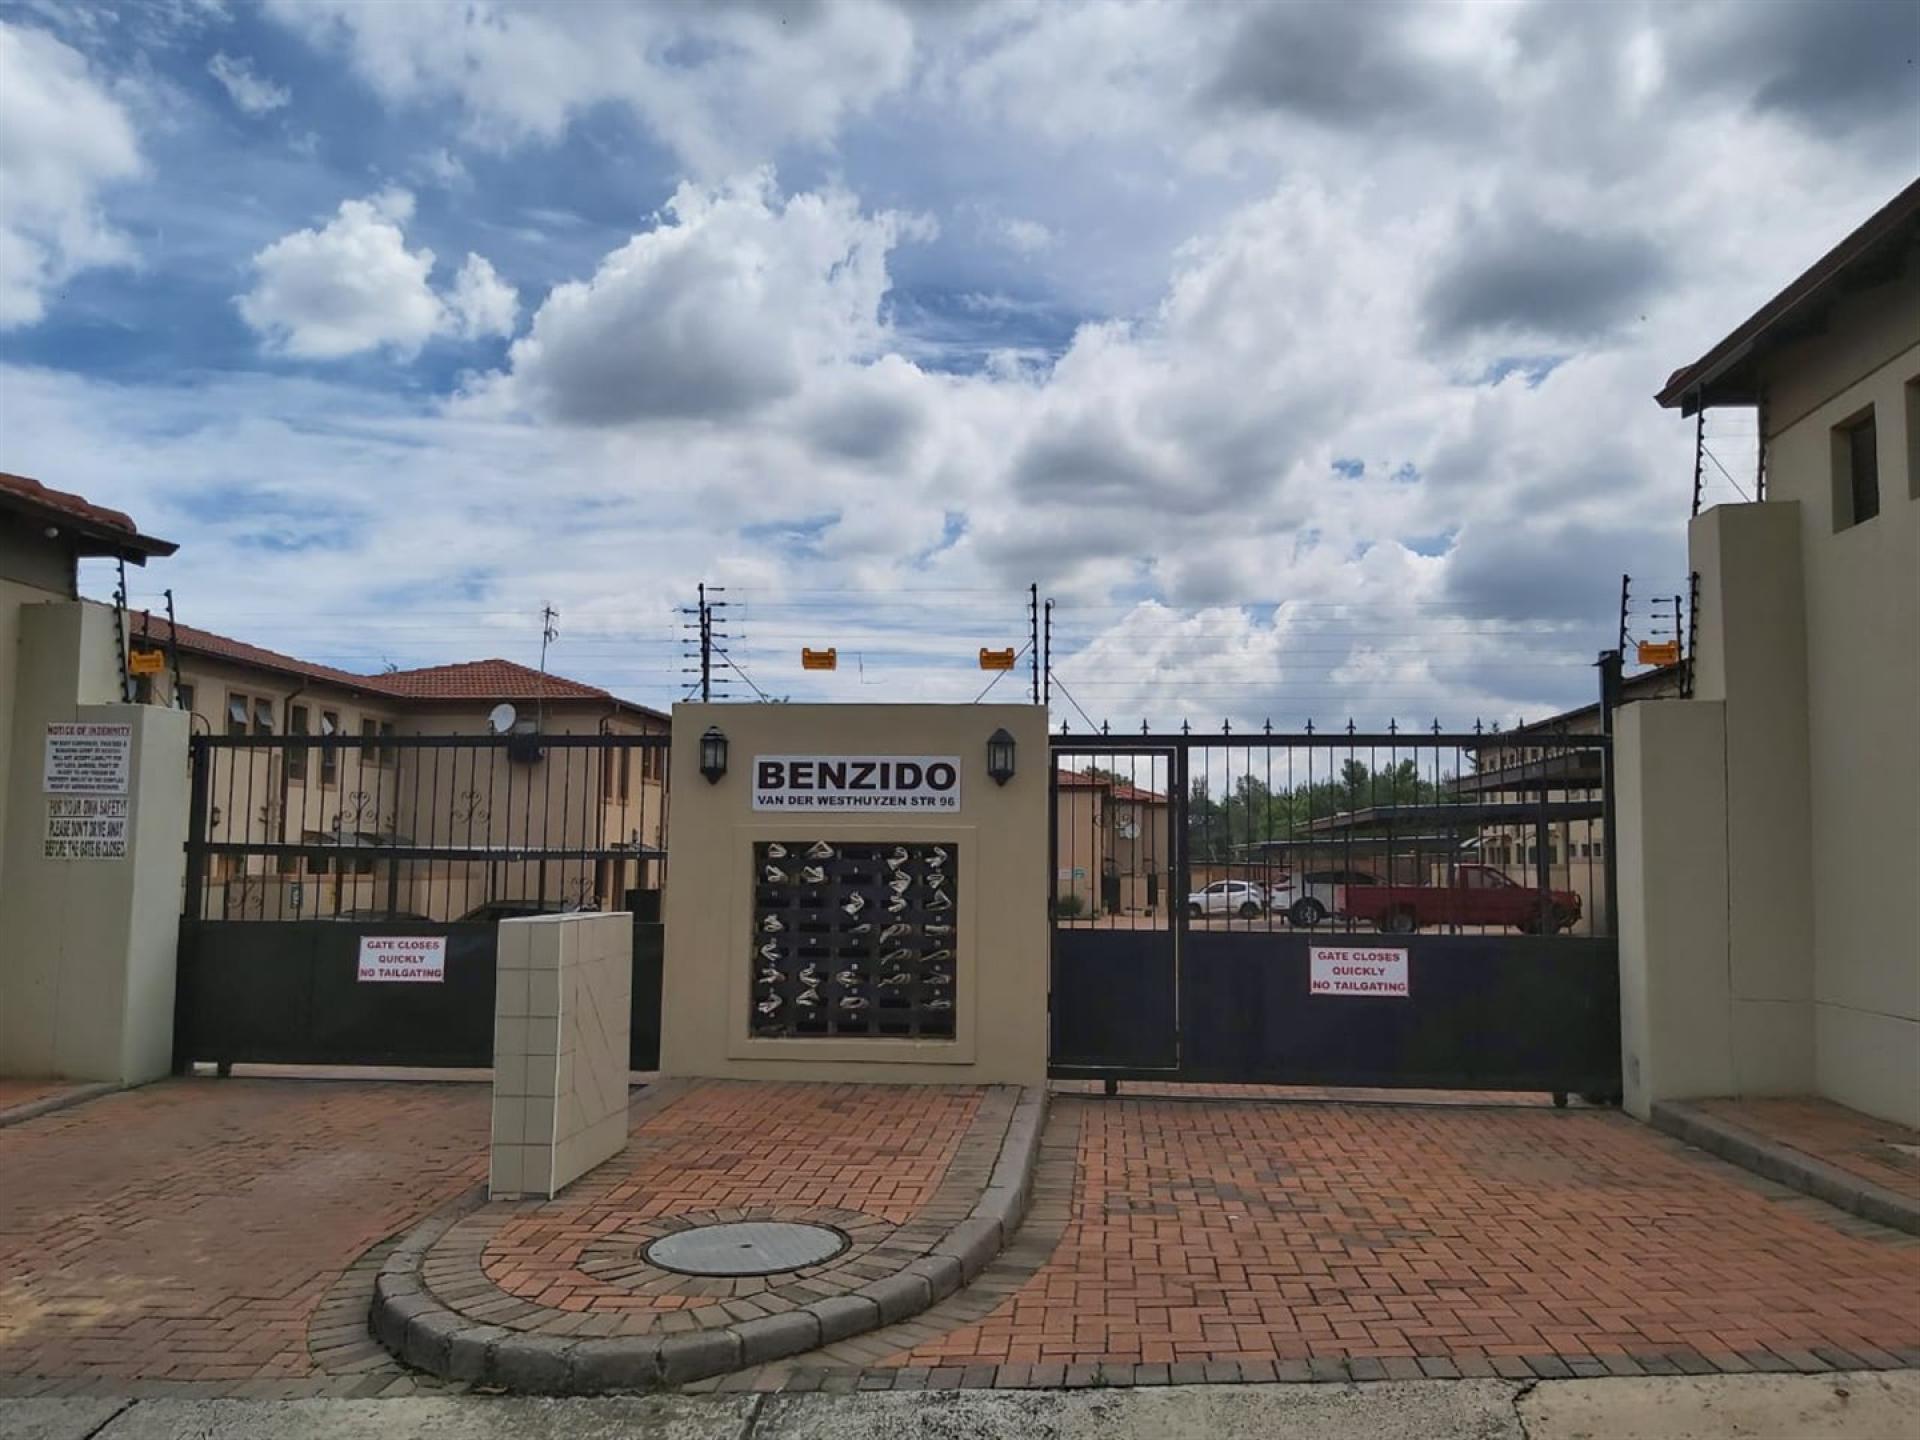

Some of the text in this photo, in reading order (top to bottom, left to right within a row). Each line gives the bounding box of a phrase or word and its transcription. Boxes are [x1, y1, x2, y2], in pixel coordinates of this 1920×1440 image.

[757, 761, 957, 791] BENZIDO
[757, 795, 955, 807] VAN DER WESTHUYZEN STR 96
[367, 940, 440, 950] GATE CLOSES
[378, 955, 425, 964] QUICKLY
[1317, 951, 1400, 962] GATE CLOSES
[360, 968, 442, 978] NO TAILGATING
[1332, 966, 1385, 976] QUICKLY
[1312, 979, 1406, 992] NO TAILGATING
